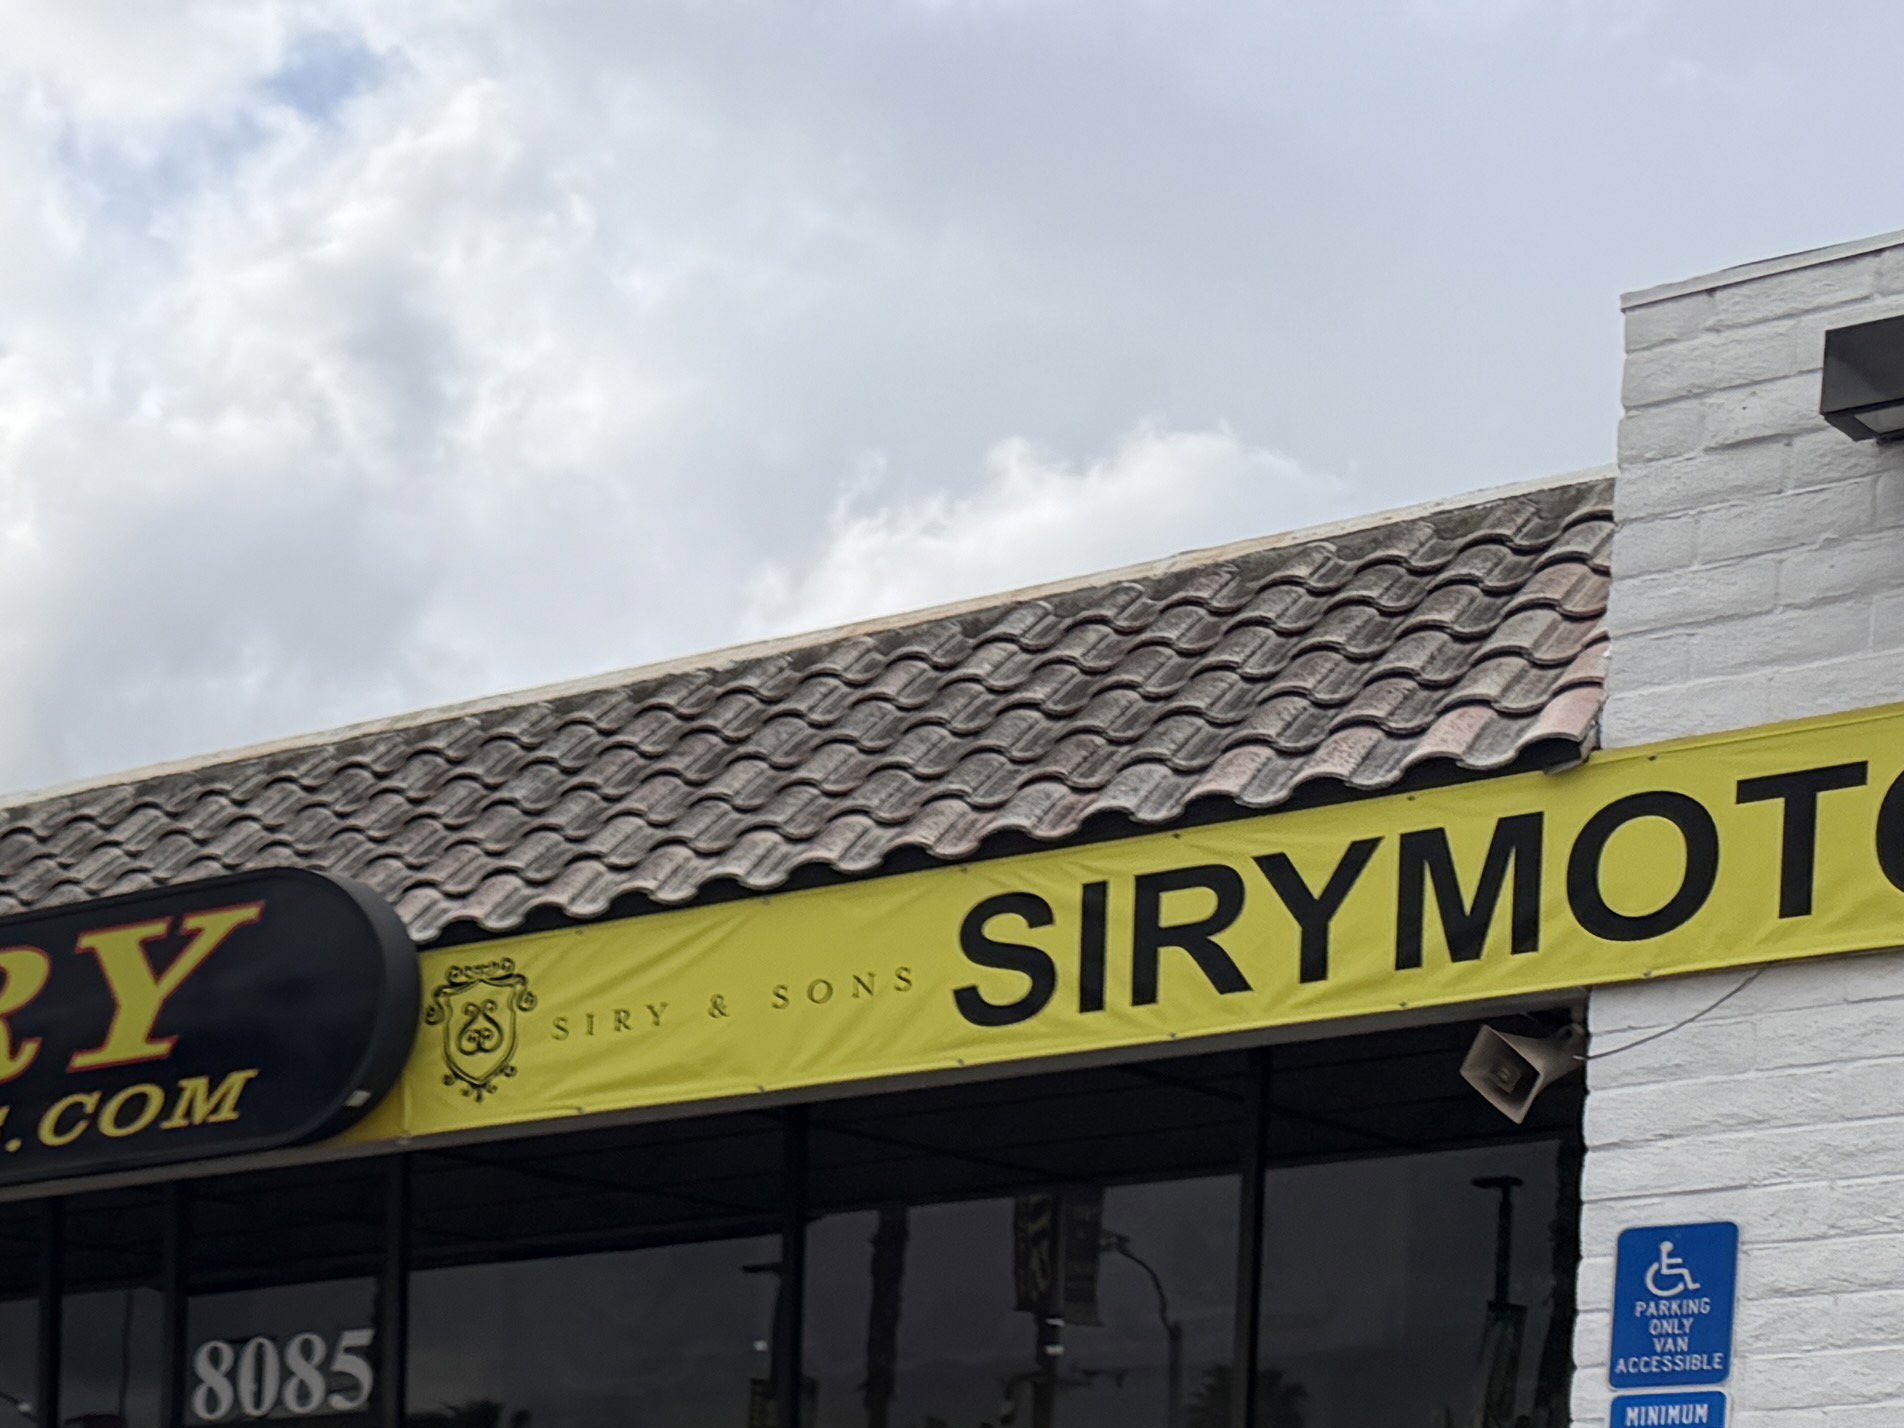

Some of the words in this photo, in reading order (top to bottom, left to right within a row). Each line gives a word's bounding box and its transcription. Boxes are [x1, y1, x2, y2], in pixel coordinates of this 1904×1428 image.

[952, 760, 1904, 1027] SIRYMOT
[551, 1000, 670, 1041] SIRY
[706, 993, 730, 1020] &
[770, 966, 914, 1010] SONS
[1635, 1297, 1711, 1318] PARKING
[1648, 1317, 1694, 1336] ONLY
[1652, 1336, 1689, 1353] VAN
[193, 1328, 376, 1421] 8085
[1615, 1352, 1724, 1374] ACCESSIBLE
[1625, 1403, 1709, 1427] MINIMUM
